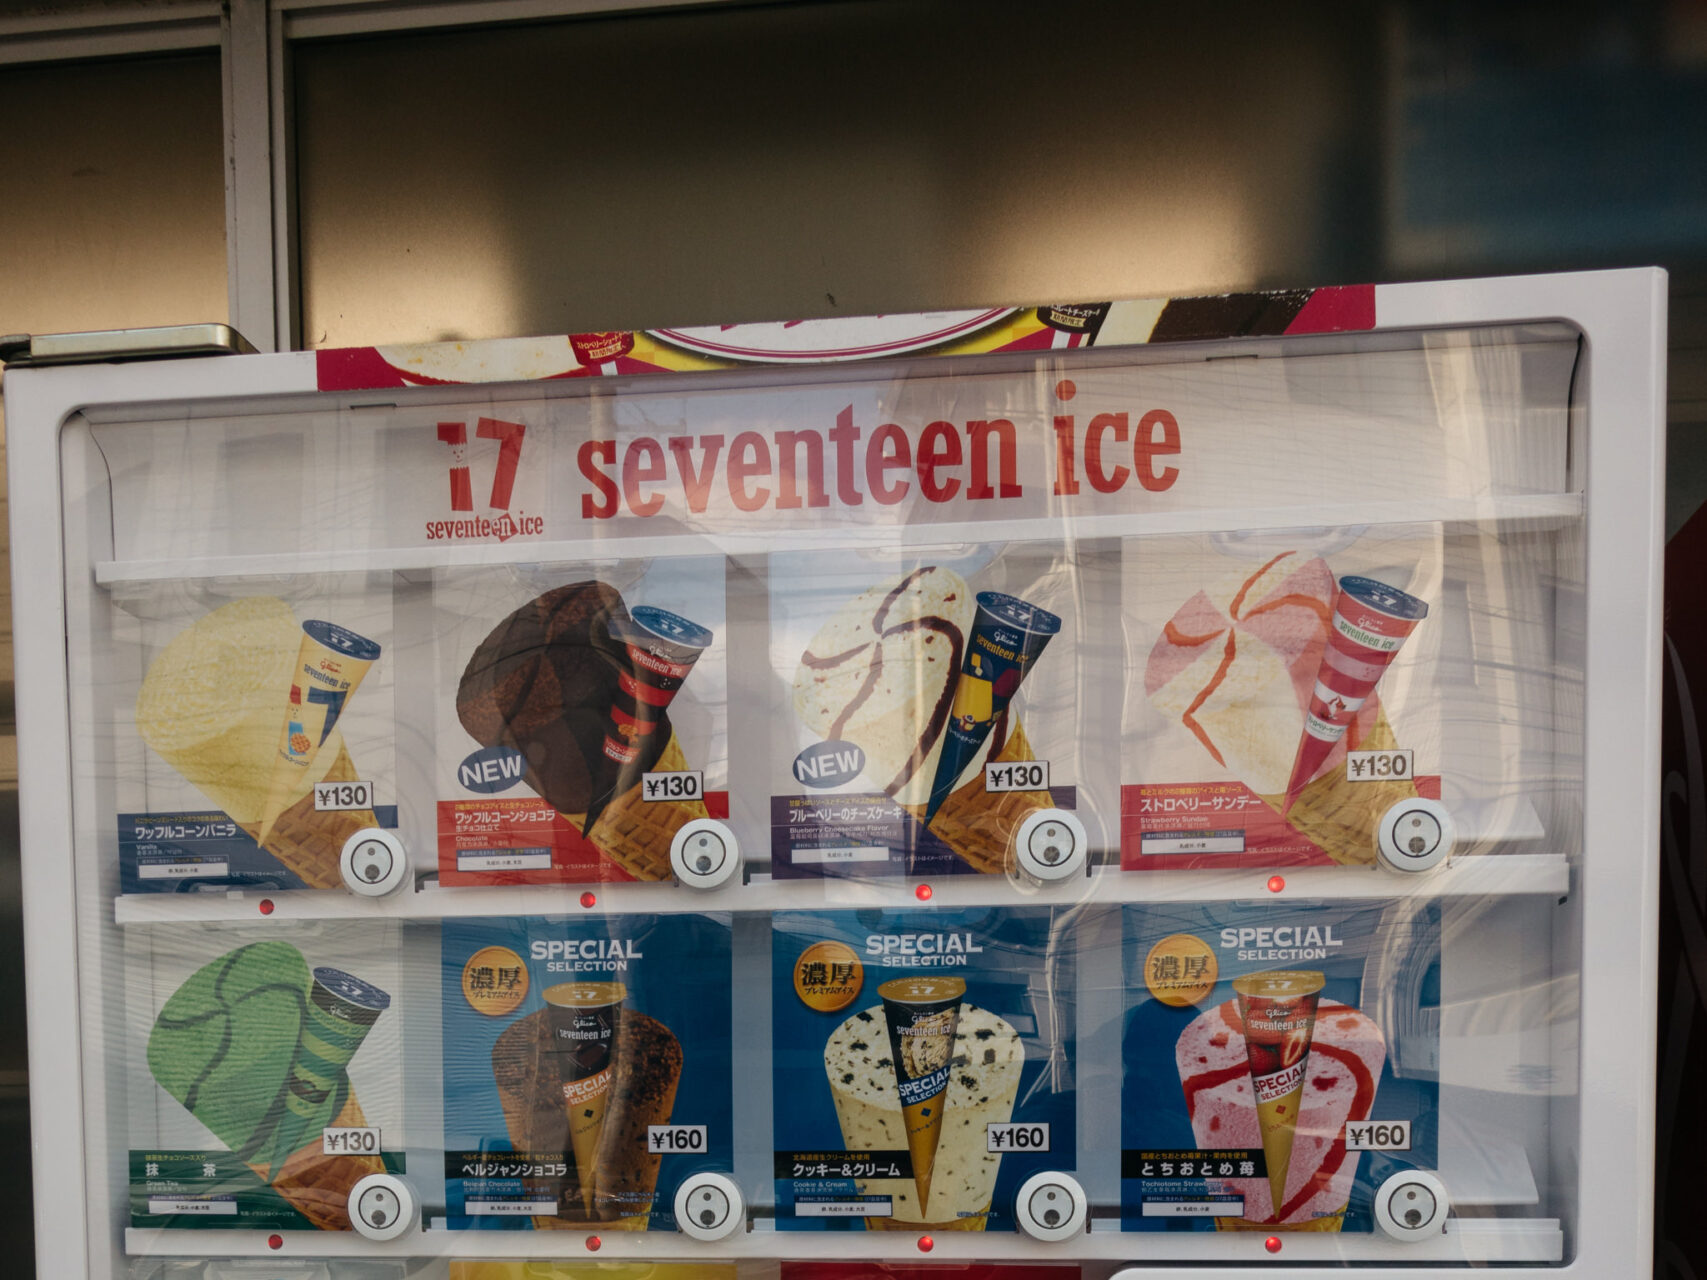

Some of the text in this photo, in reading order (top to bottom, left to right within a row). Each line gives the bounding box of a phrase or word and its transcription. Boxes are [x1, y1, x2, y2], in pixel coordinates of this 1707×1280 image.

[576, 379, 1182, 520] seventeen ice
[437, 417, 526, 512] 17
[426, 510, 543, 542] seventeen ice
[1340, 620, 1395, 650] seventeen ice
[460, 755, 522, 786] NEW
[796, 749, 860, 781] NEW
[1351, 754, 1407, 776] ¥130
[647, 776, 697, 797] ¥130
[989, 766, 1043, 787] ¥130
[318, 786, 367, 806] ¥130
[1140, 795, 1261, 812] ストロベリーサンデー
[455, 810, 555, 823] ワッフルコーンショコラ
[789, 806, 902, 823] ブルーベリーのチーズケーキ
[135, 824, 236, 840] ワッフルコーンバニラ
[865, 933, 983, 955] SPECIAL
[1220, 926, 1343, 948] SPECIAL
[530, 939, 643, 960] SPECIAL
[1237, 948, 1326, 961] SELECTION
[546, 960, 628, 973] SELECTION
[882, 955, 967, 967] SELECTION
[1153, 954, 1210, 981] 濃厚
[470, 966, 521, 991] 濃厚
[801, 962, 856, 987] 濃厚
[472, 990, 520, 999] プレミアムアイス
[805, 986, 855, 996] プレミアムアイス
[560, 1027, 611, 1041] seventeen ice
[896, 1024, 951, 1037] seventeen ice
[1251, 1020, 1294, 1032] seventeen
[563, 1069, 611, 1098] SPECIAL
[899, 1068, 951, 1097] SPECIAL
[1253, 1064, 1306, 1093] SPECIAL
[327, 1132, 375, 1151] ¥130
[652, 1130, 702, 1149] ¥160
[992, 1127, 1044, 1147] ¥160
[1350, 1126, 1405, 1146] ¥160
[145, 1163, 216, 1177] 抹茶
[462, 1163, 567, 1177] ベルジャンショコラ
[792, 1163, 901, 1177] クッキー&クリーム
[1141, 1161, 1255, 1176] とちおとめ苺
